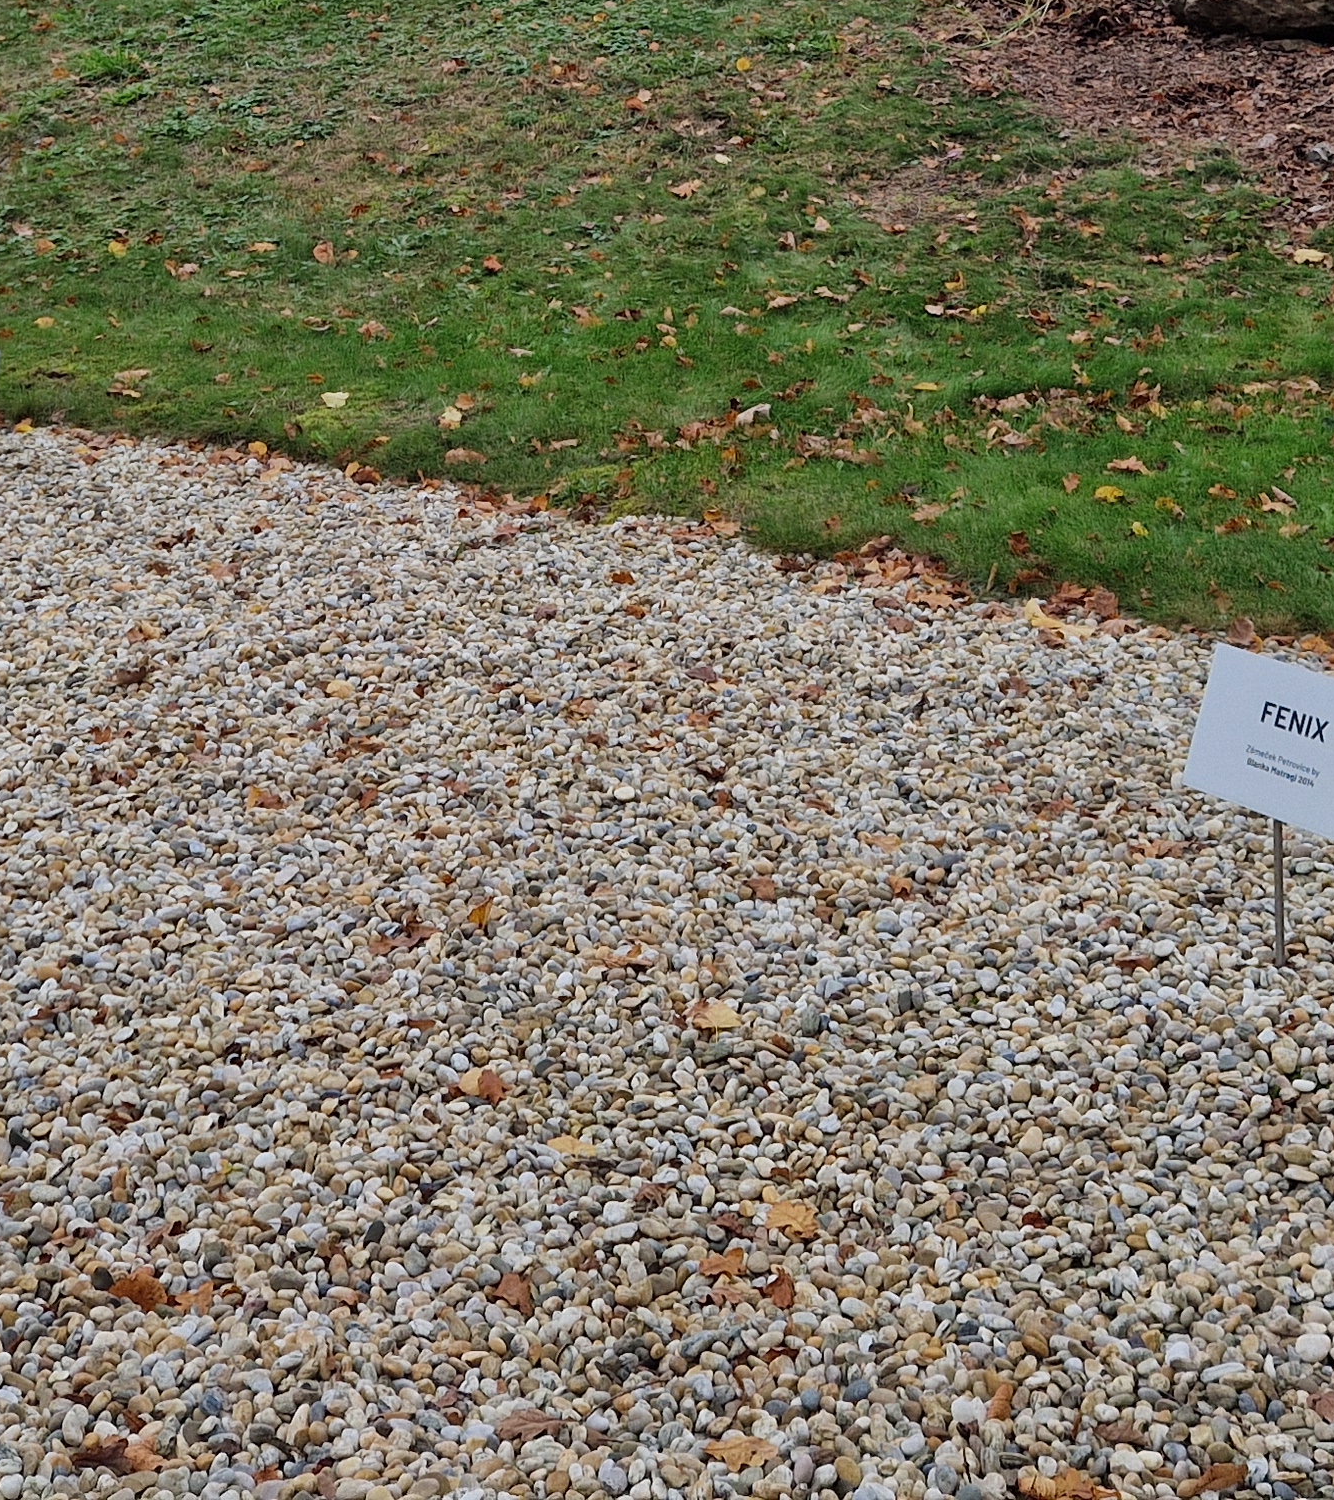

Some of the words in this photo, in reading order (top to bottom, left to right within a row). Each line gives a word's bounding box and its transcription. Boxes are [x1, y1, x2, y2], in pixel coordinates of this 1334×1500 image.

[1261, 701, 1329, 743] FENIX
[1278, 755, 1310, 773] Petrovice
[1311, 768, 1320, 778] by
[1298, 776, 1314, 787] 2014
